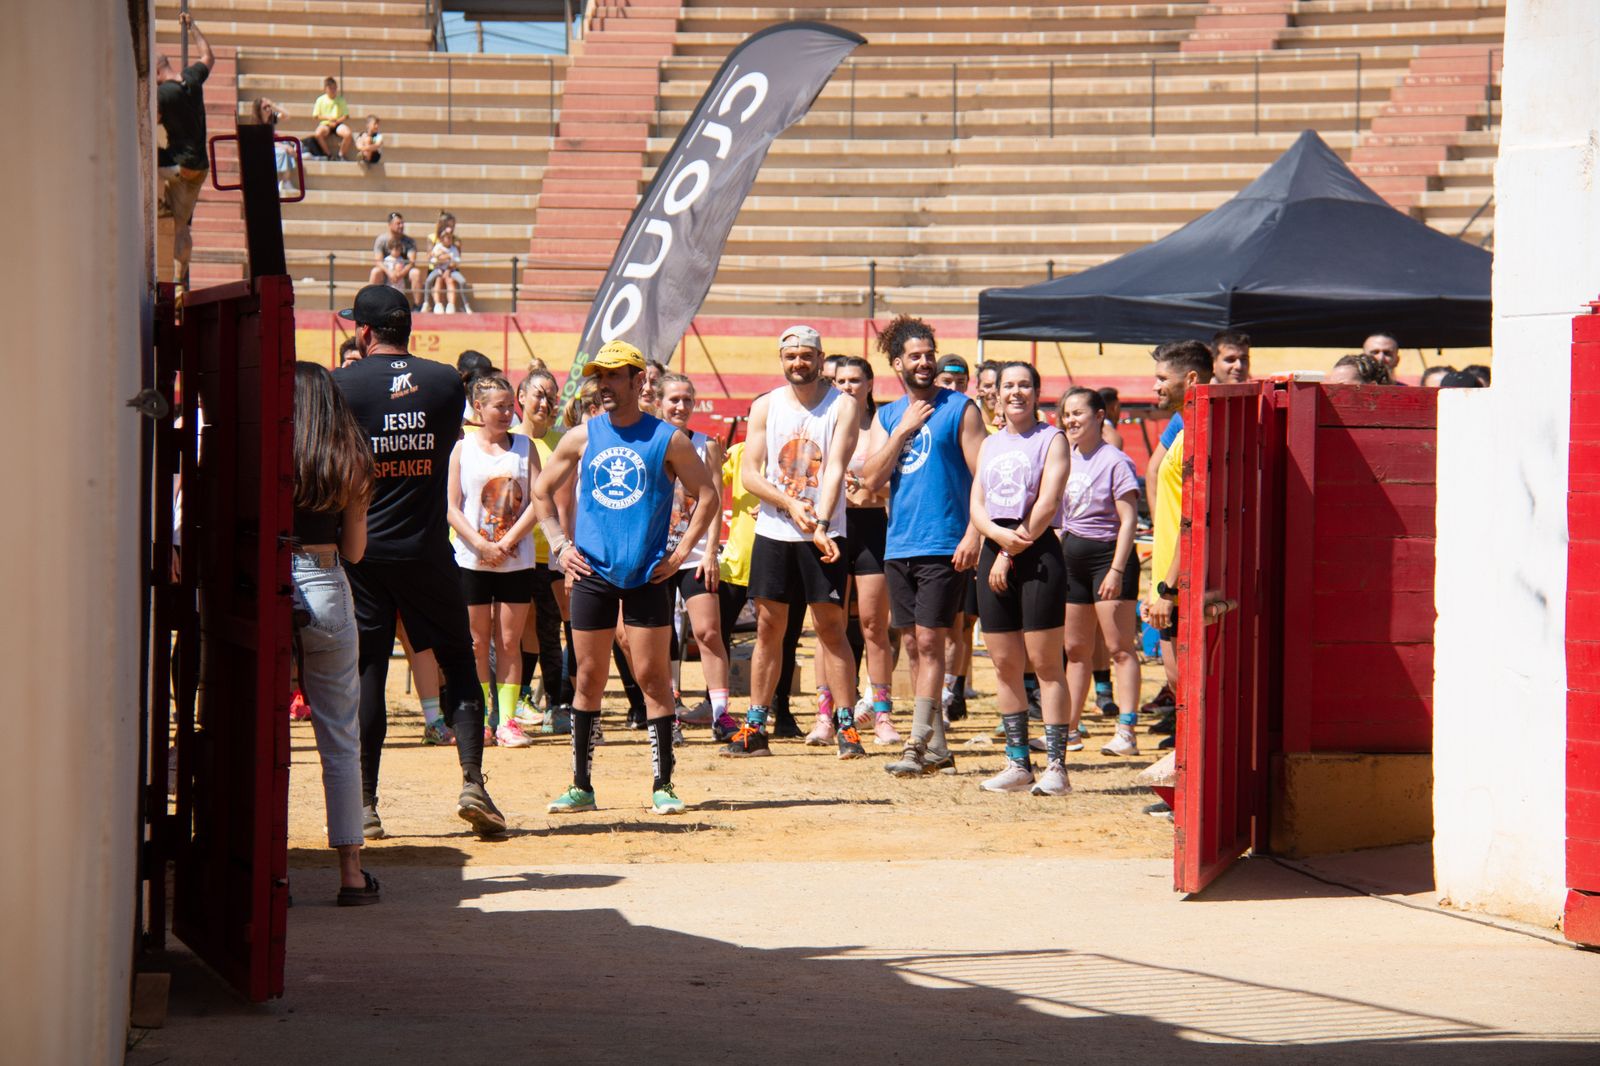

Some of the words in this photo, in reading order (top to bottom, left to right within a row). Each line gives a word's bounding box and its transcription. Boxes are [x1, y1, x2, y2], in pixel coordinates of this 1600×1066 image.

[601, 71, 768, 342] crono
[383, 411, 426, 431] JESUS
[371, 433, 435, 454] TRUCKER
[373, 458, 432, 478] SPEAKER
